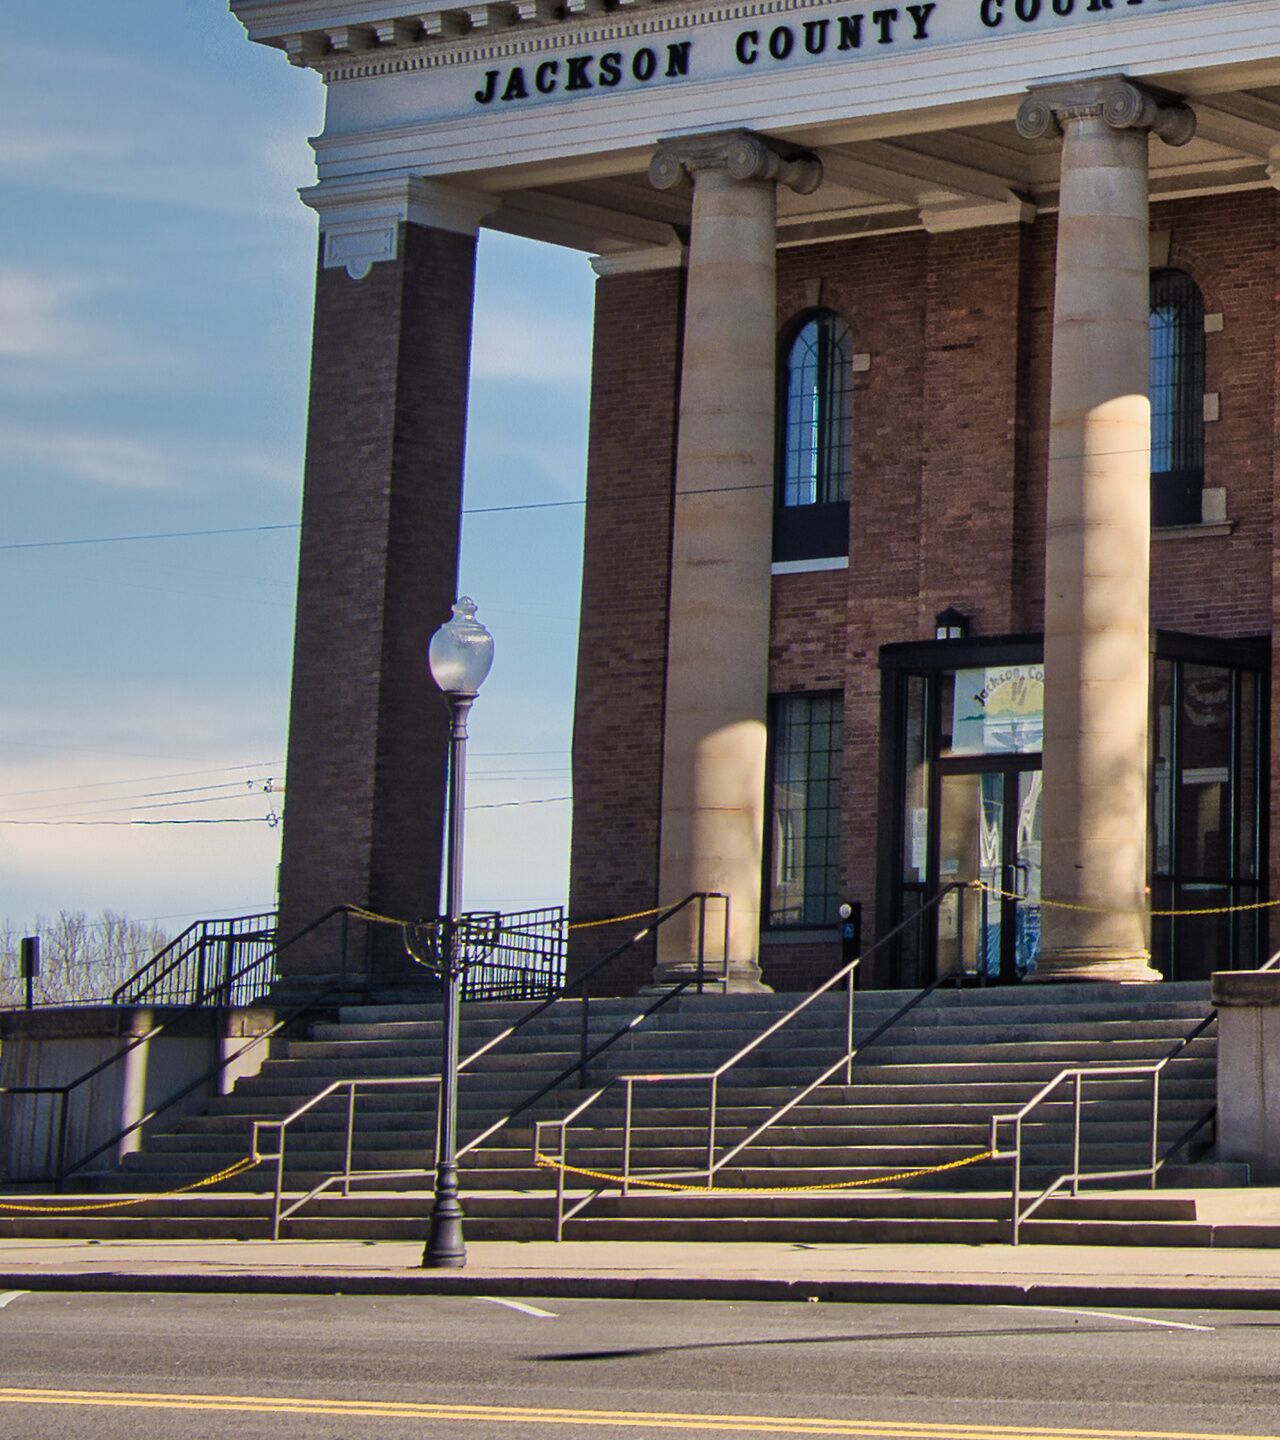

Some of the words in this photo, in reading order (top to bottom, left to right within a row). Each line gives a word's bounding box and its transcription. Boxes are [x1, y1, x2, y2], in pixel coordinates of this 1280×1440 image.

[474, 41, 693, 105] JACKSON
[735, 2, 937, 65] COUNTY
[974, 668, 1020, 707] Jackson
